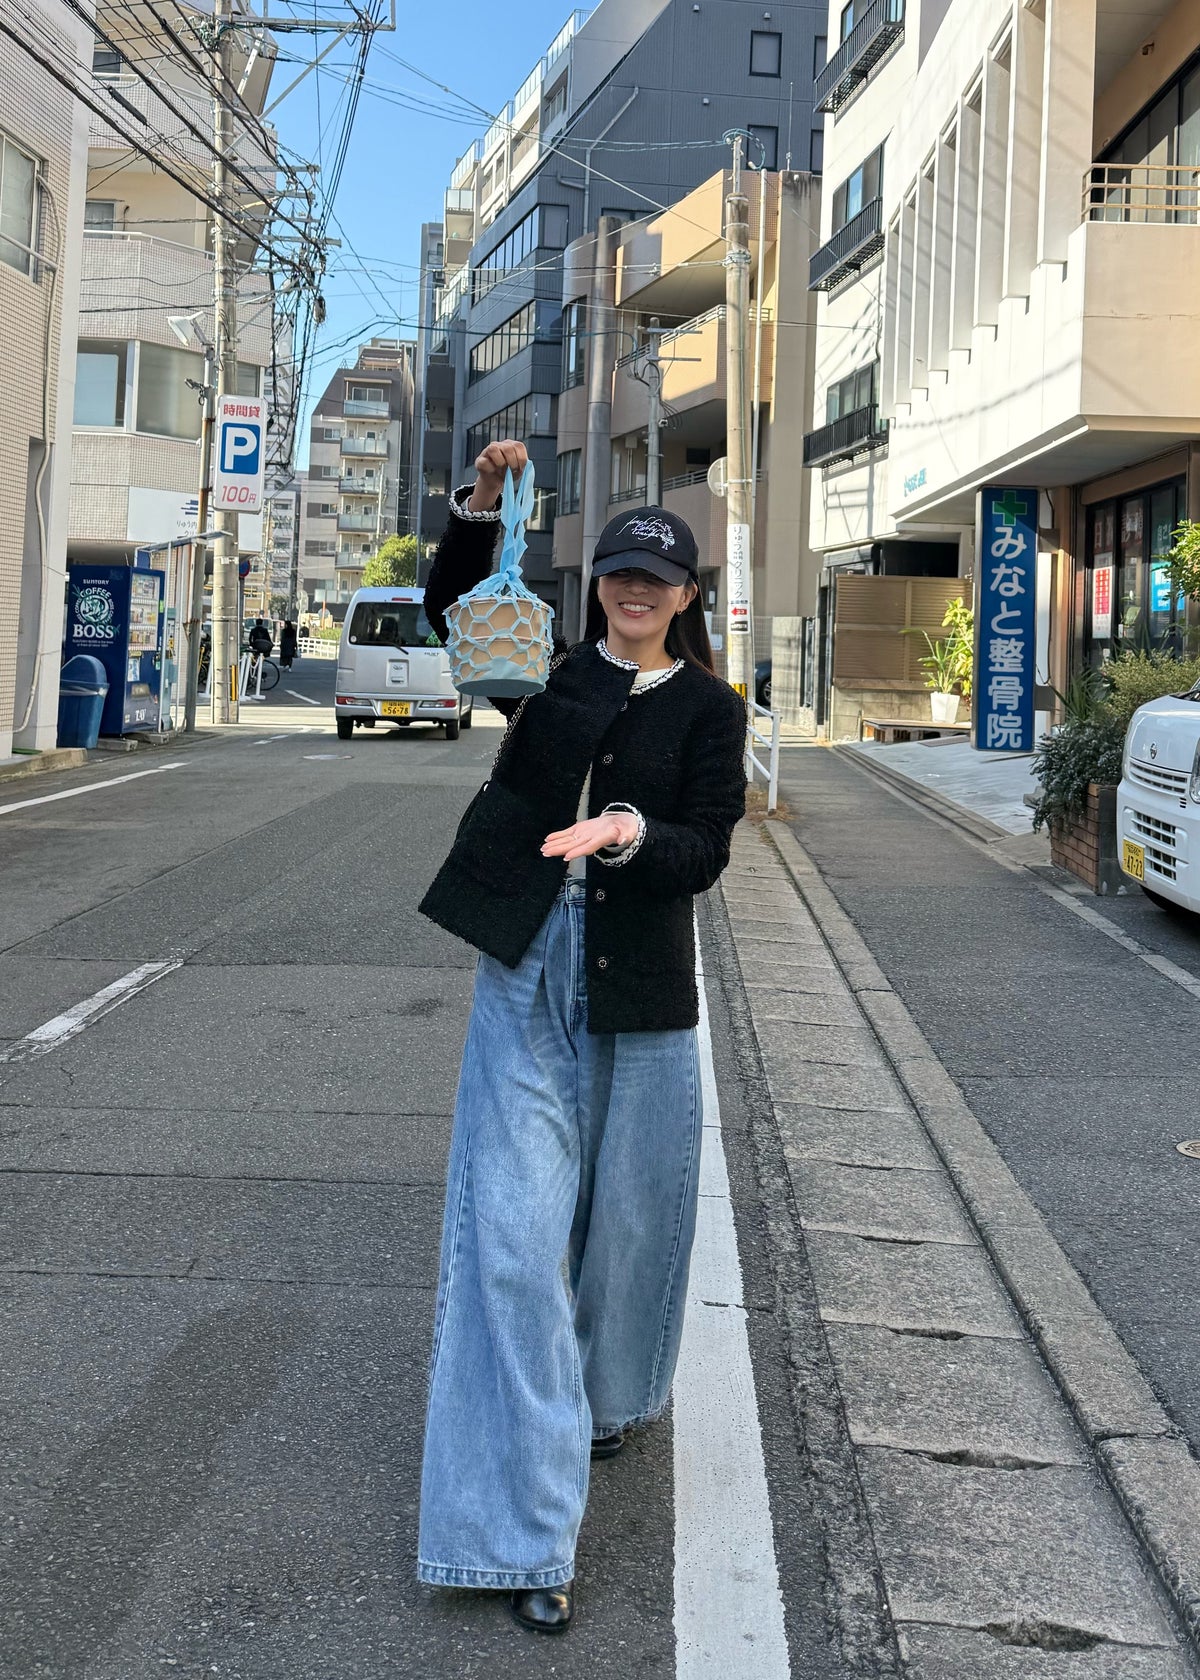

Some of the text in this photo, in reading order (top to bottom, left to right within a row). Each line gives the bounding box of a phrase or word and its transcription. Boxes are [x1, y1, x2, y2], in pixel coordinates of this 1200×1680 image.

[223, 404, 260, 417] 時間貸
[224, 426, 257, 470] P
[222, 486, 256, 503] 100円
[80, 587, 112, 599] COFFEE
[73, 624, 114, 638] BOSS
[987, 526, 1027, 748] みなと整骨院
